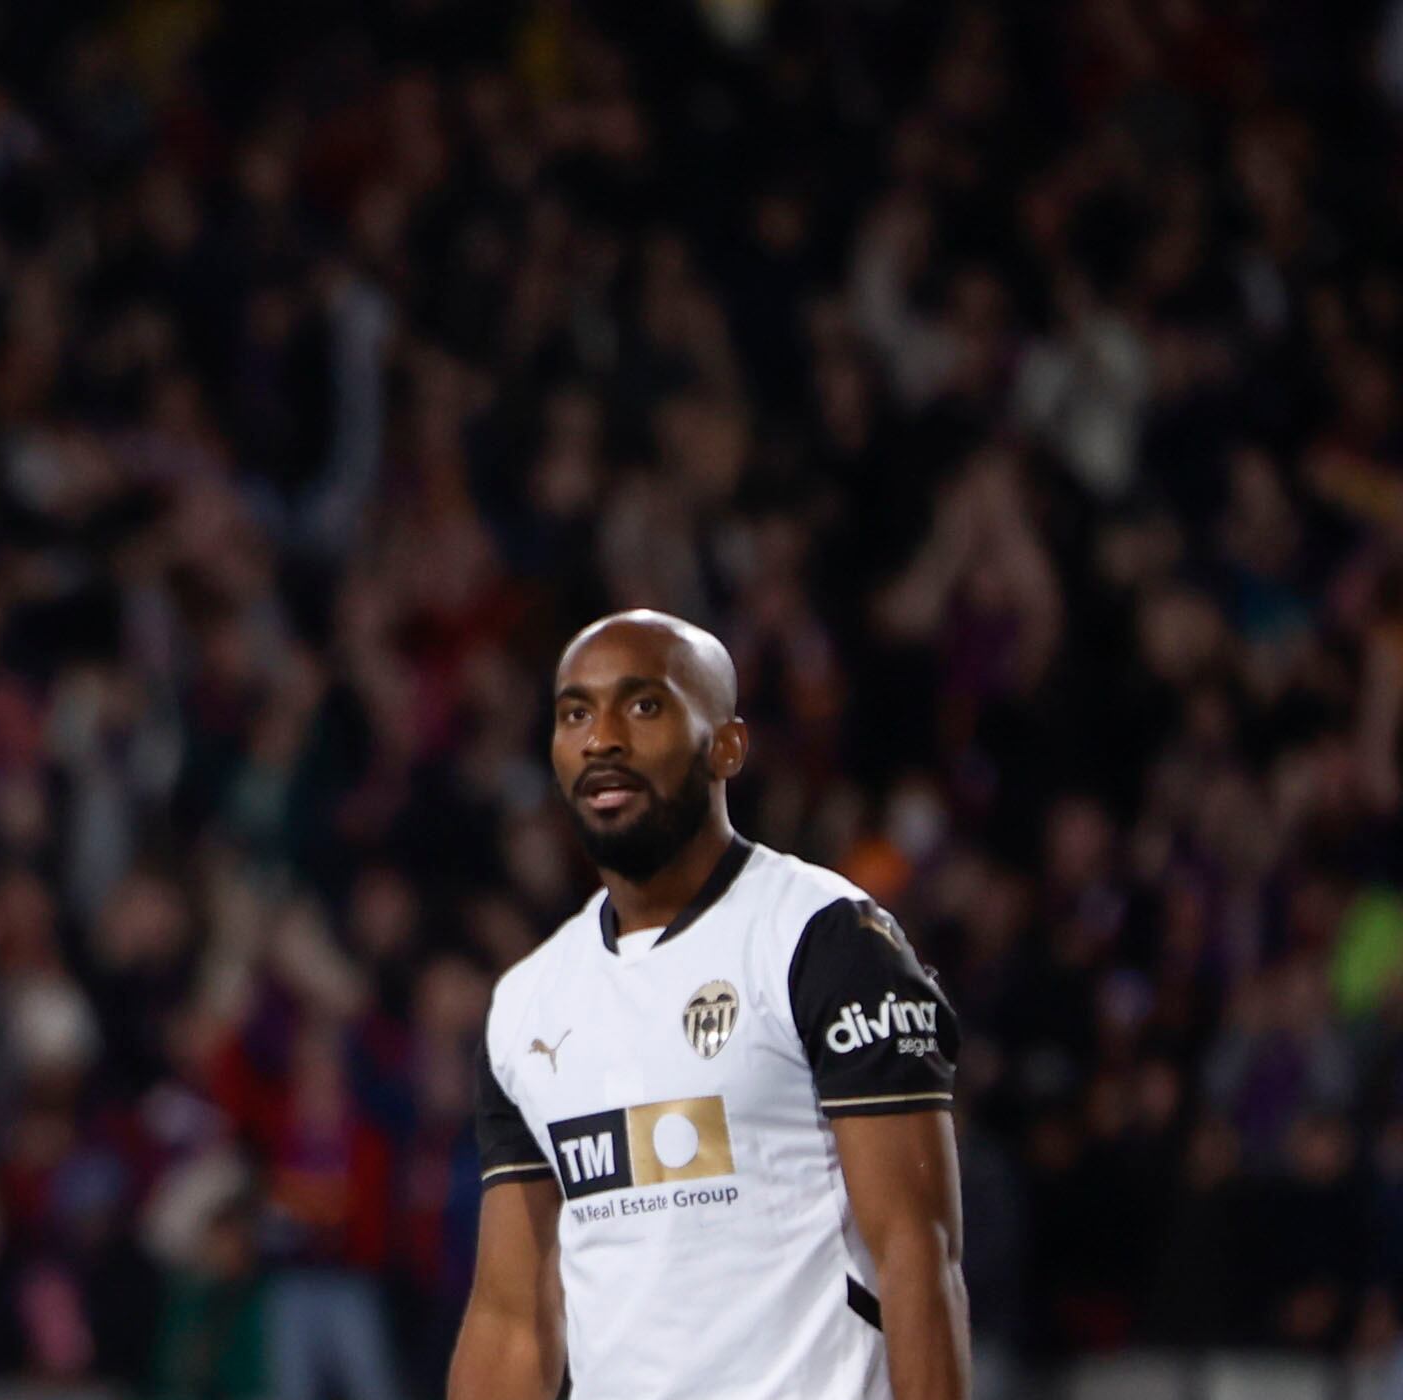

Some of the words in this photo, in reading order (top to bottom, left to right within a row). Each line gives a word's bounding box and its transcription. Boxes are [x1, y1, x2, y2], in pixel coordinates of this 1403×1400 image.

[826, 991, 937, 1054] divina
[560, 1131, 616, 1184] TM
[587, 1200, 616, 1222] Real
[621, 1195, 669, 1217] Estate
[673, 1186, 740, 1209] Group
